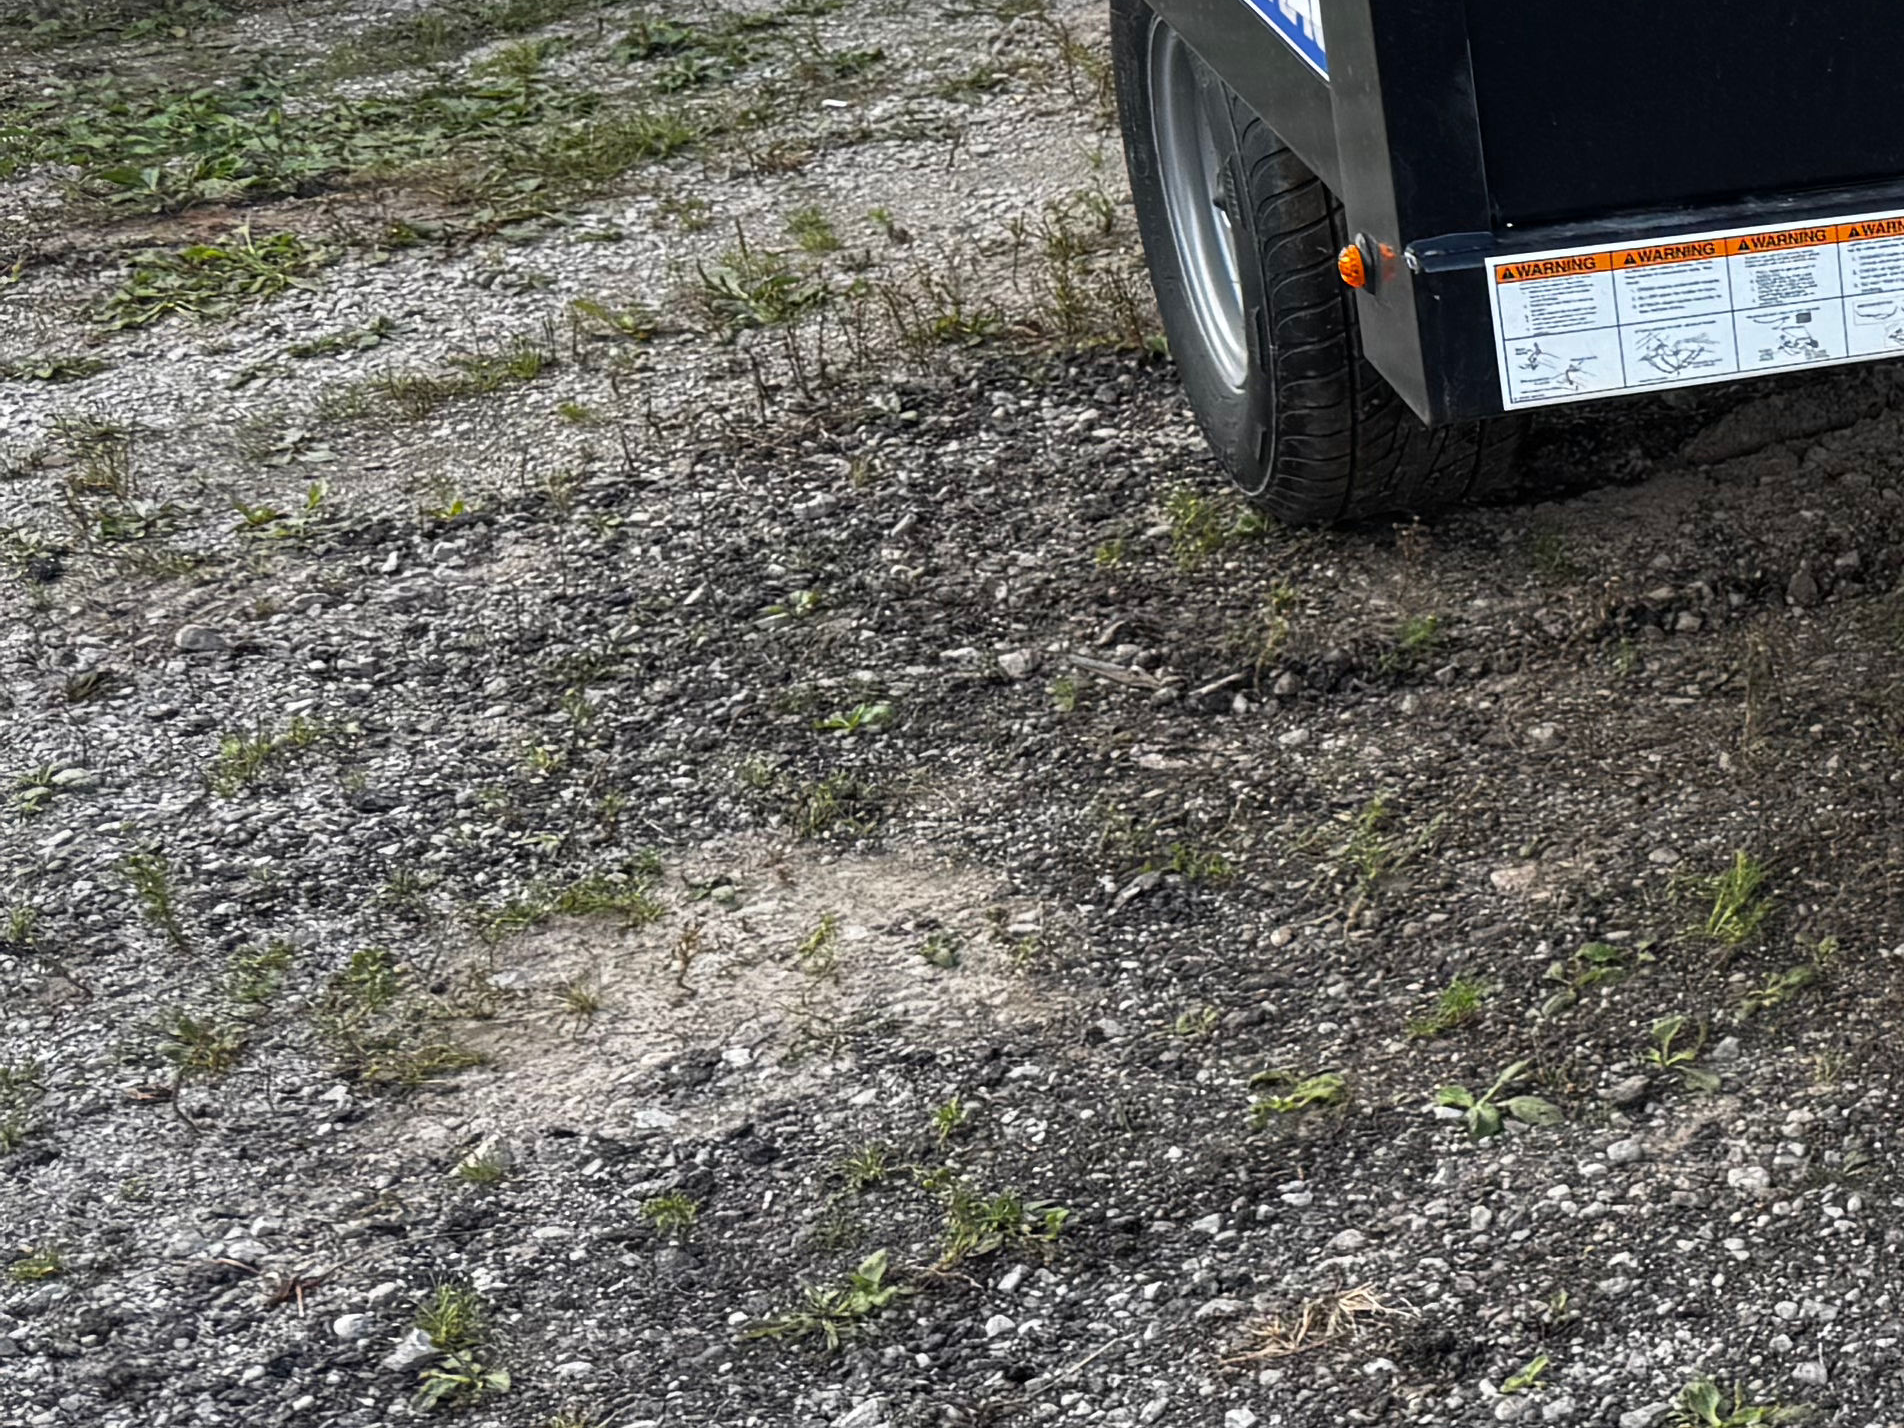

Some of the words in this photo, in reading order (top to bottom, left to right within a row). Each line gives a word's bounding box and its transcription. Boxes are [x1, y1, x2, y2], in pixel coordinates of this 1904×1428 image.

[1514, 256, 1597, 278] WARNING
[1637, 241, 1717, 264] WARNING
[1750, 228, 1827, 250] WARNING
